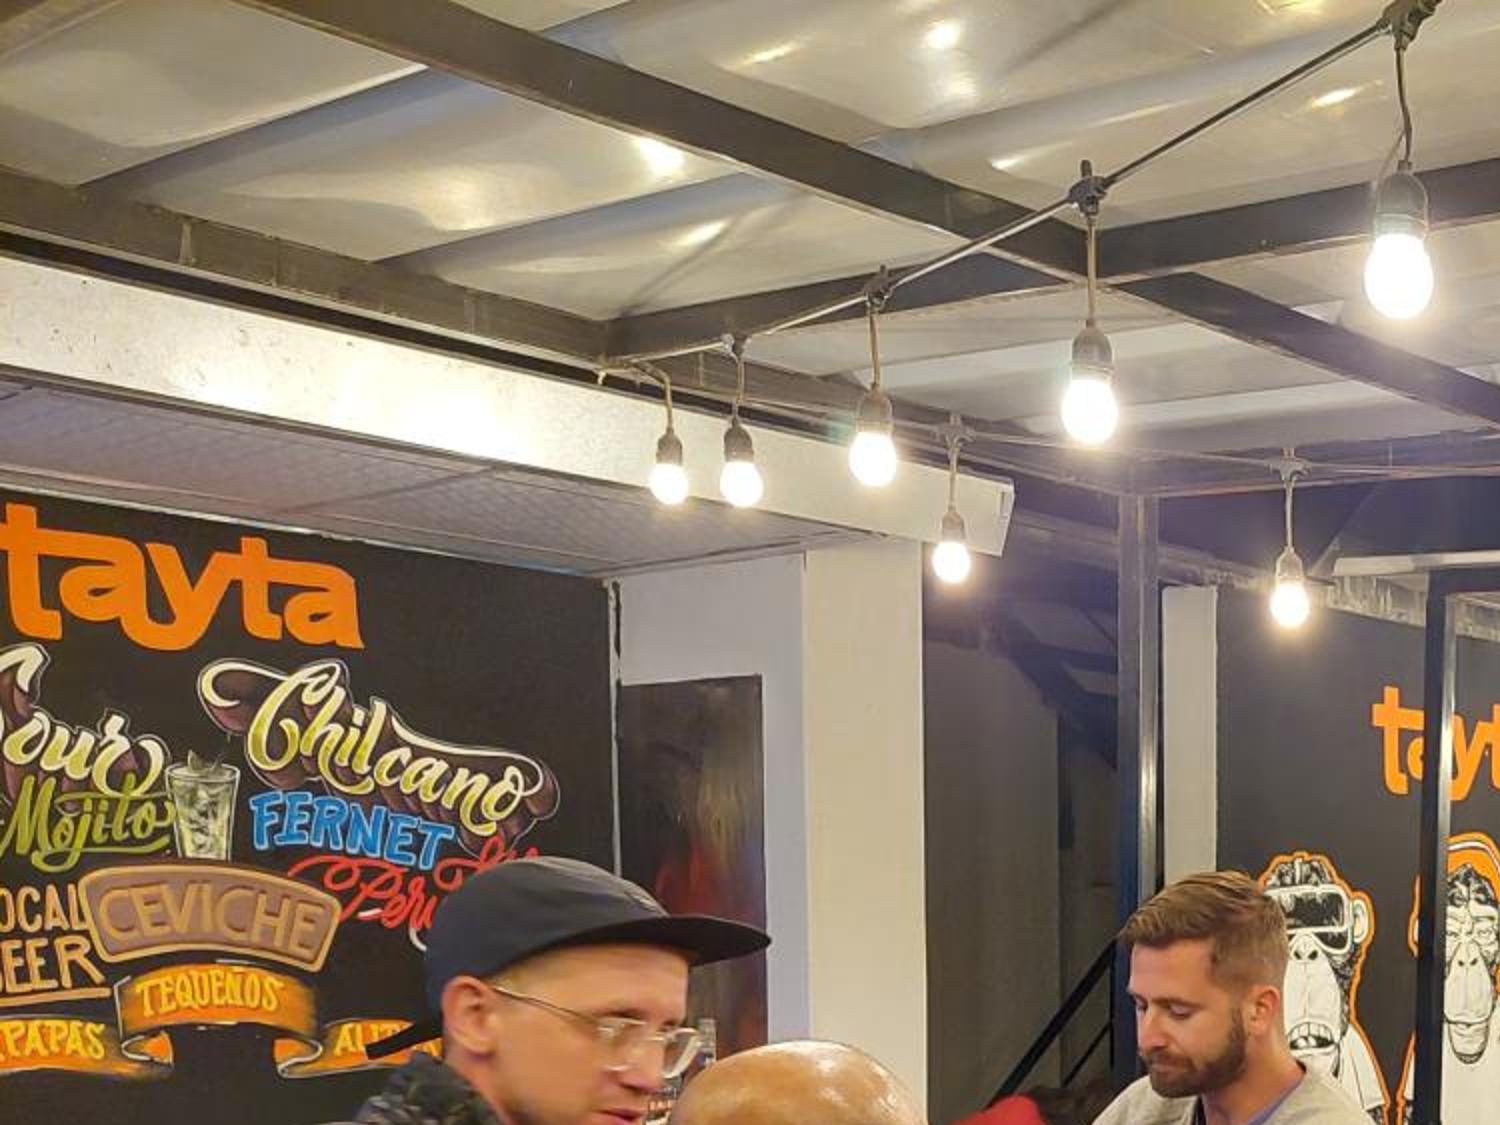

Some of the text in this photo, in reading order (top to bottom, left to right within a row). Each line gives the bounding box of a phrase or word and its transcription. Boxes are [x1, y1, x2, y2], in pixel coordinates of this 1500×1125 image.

[0, 502, 364, 651] tayta
[201, 660, 544, 836] Chilcano
[0, 774, 177, 873] Mojito
[250, 790, 456, 871] FERNET
[0, 884, 87, 933] OCAL
[100, 880, 325, 958] CEVICHE
[0, 935, 105, 993] EER
[0, 1018, 105, 1060] PAPAS
